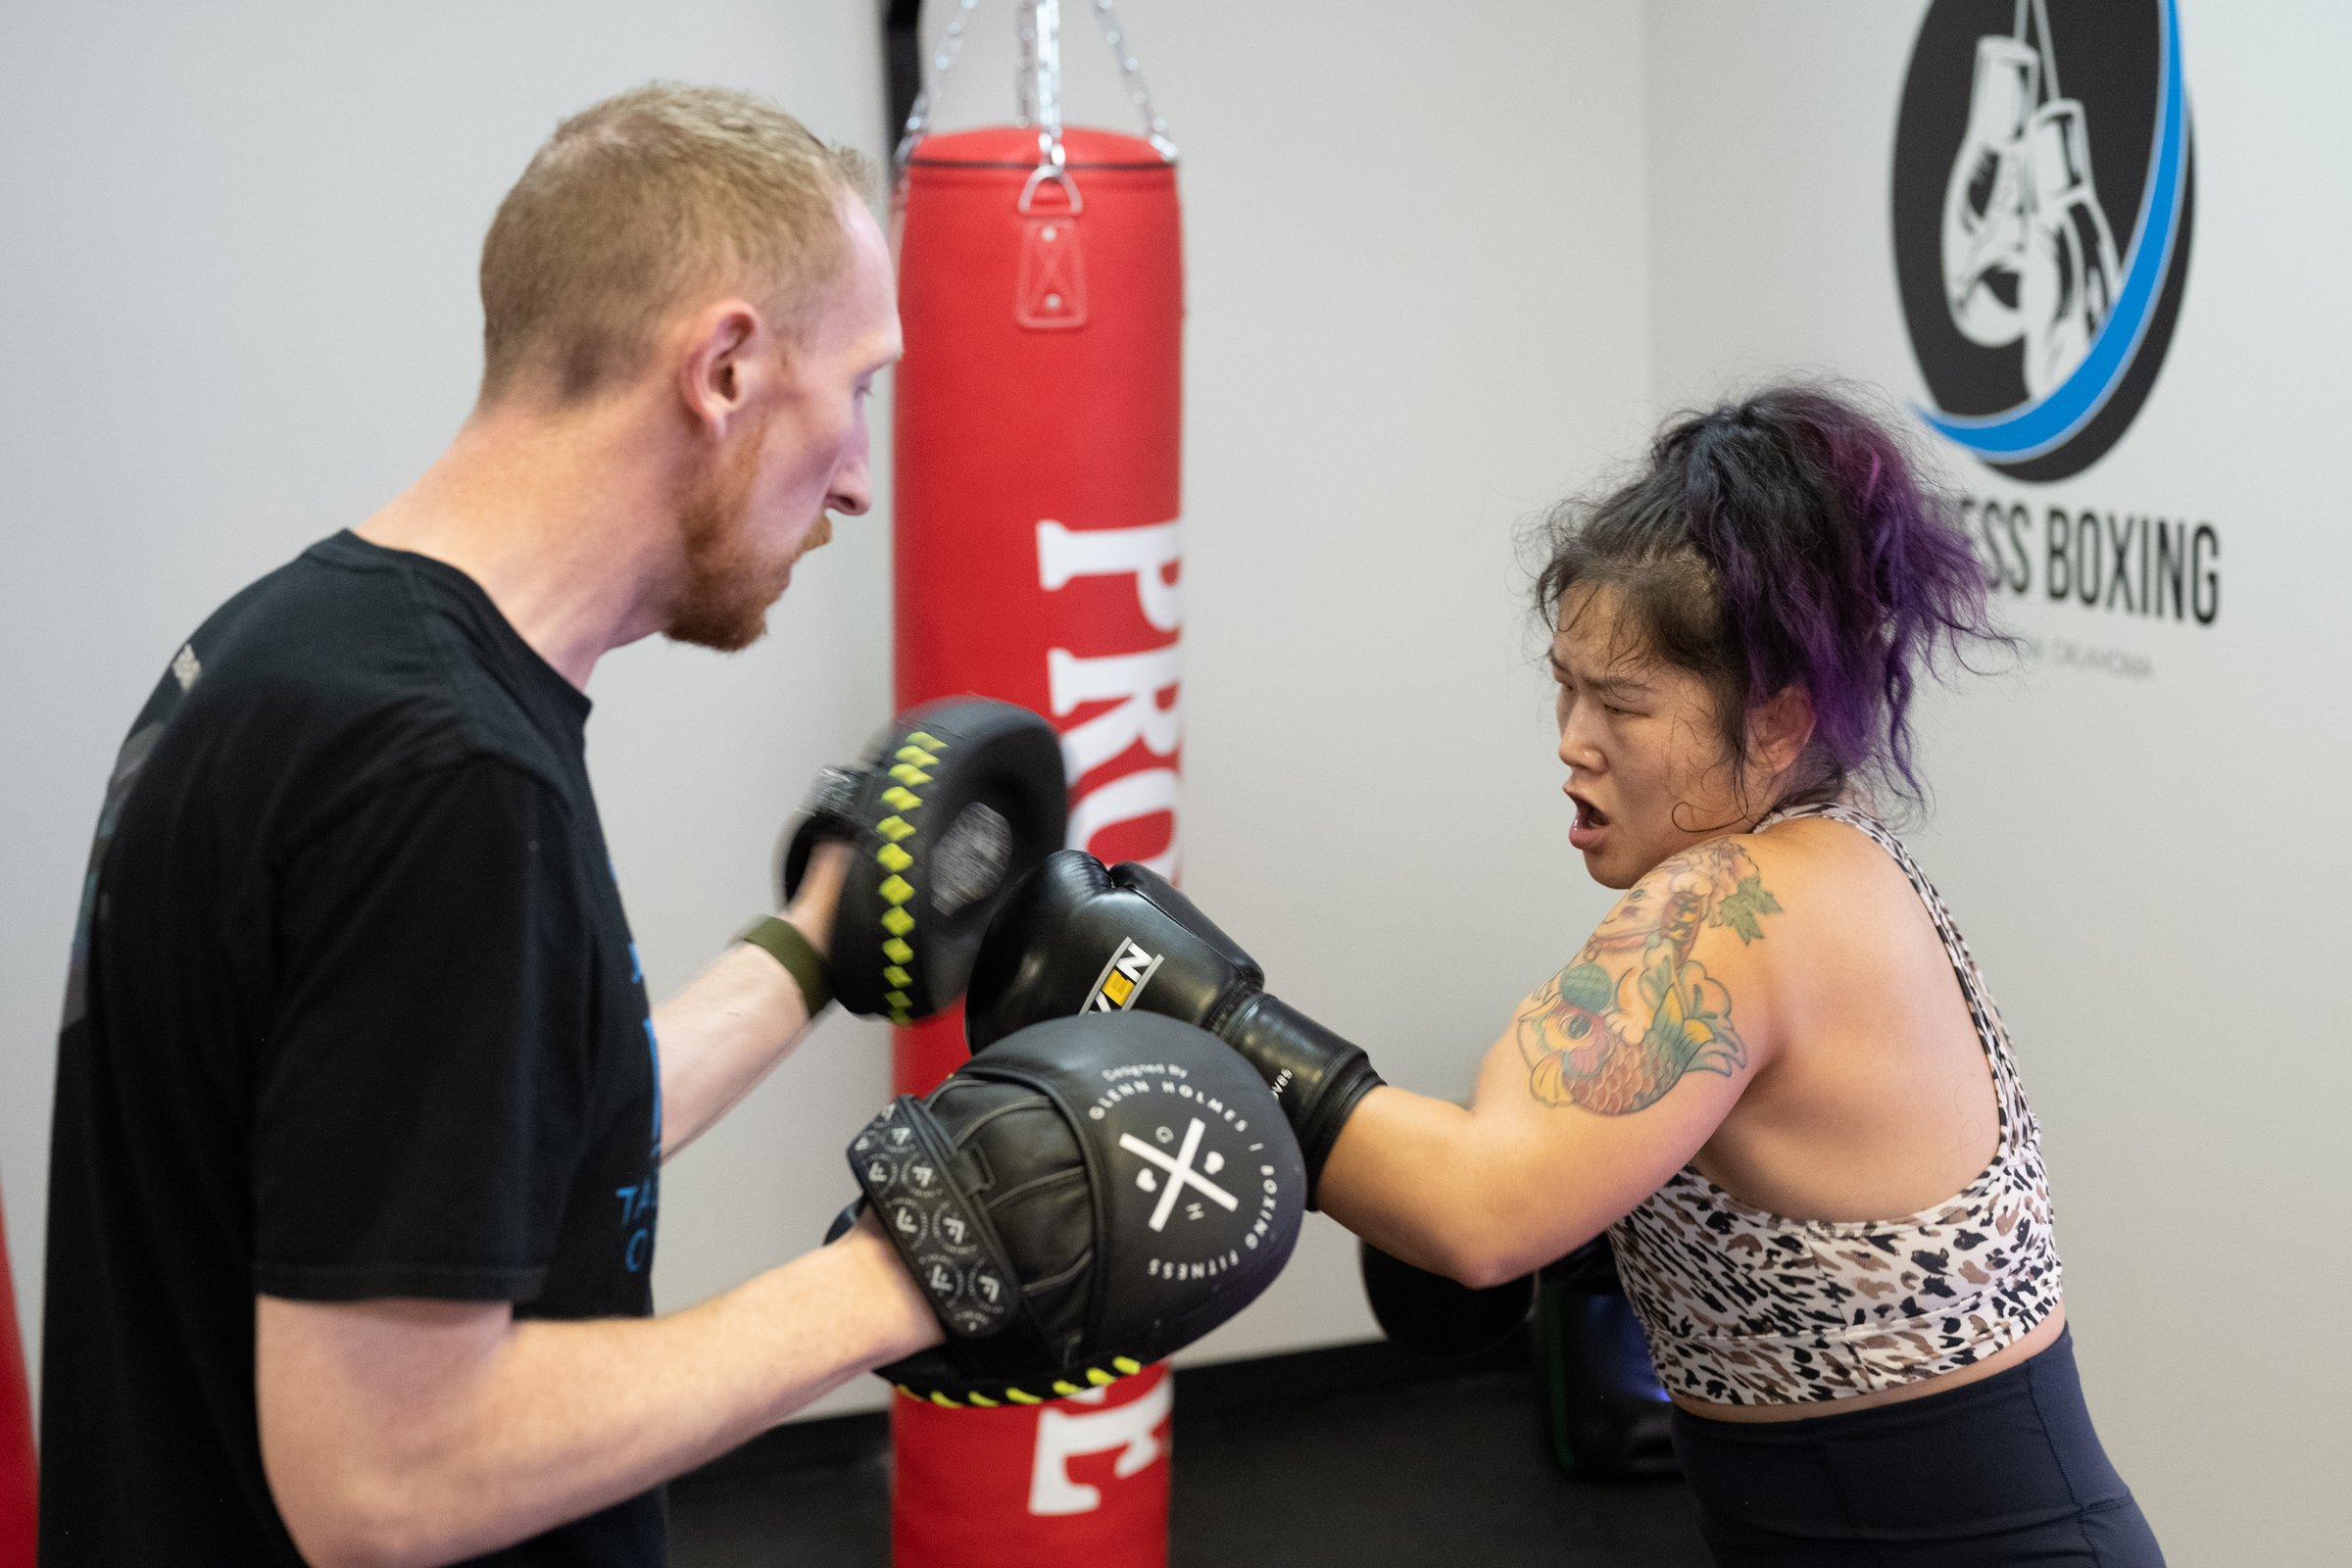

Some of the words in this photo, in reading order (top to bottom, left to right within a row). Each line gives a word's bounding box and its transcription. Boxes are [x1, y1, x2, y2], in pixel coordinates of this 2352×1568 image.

[2046, 506, 2219, 625] BOXING
[1088, 1079, 1151, 1121] GLENN
[1161, 1080, 1250, 1133] HOLMES
[1246, 1163, 1278, 1250] BOXING
[1147, 1248, 1240, 1281] FITNESS
